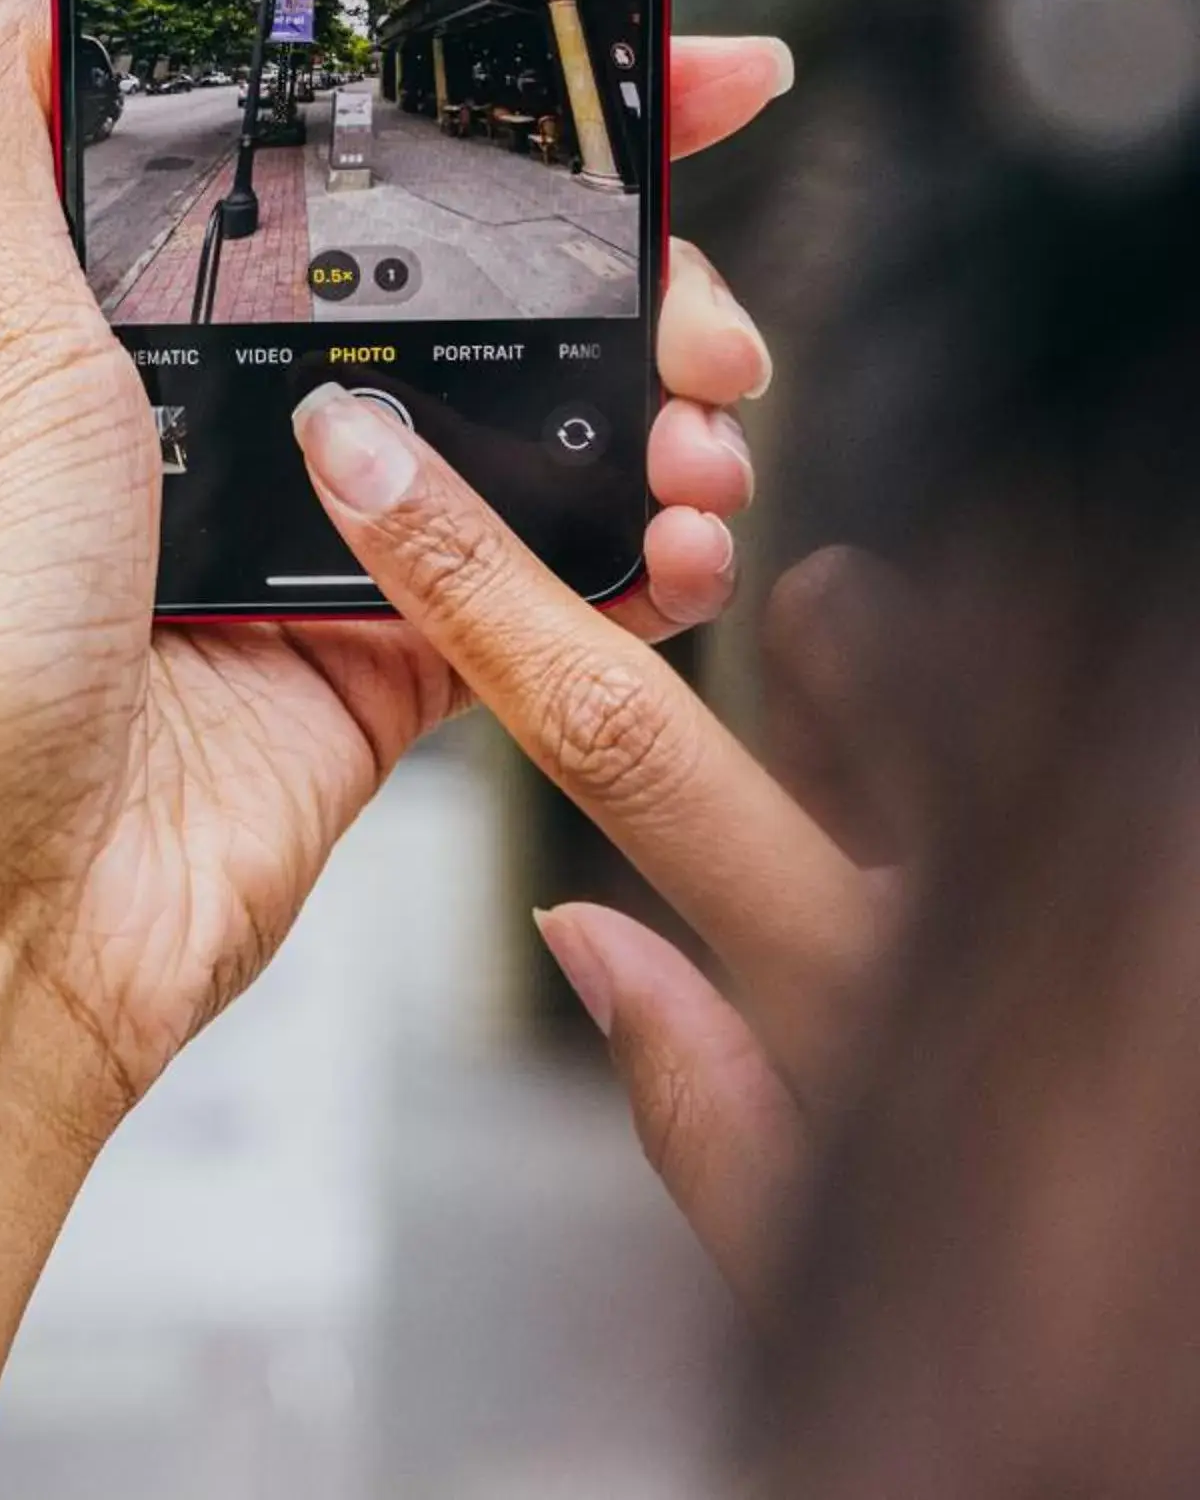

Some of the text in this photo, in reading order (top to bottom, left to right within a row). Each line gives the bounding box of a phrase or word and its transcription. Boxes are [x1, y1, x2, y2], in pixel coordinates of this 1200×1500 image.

[387, 268, 396, 283] 1
[235, 348, 293, 365] VIDEO
[329, 346, 396, 364] PHOTO
[433, 344, 525, 362] PORTRAIT
